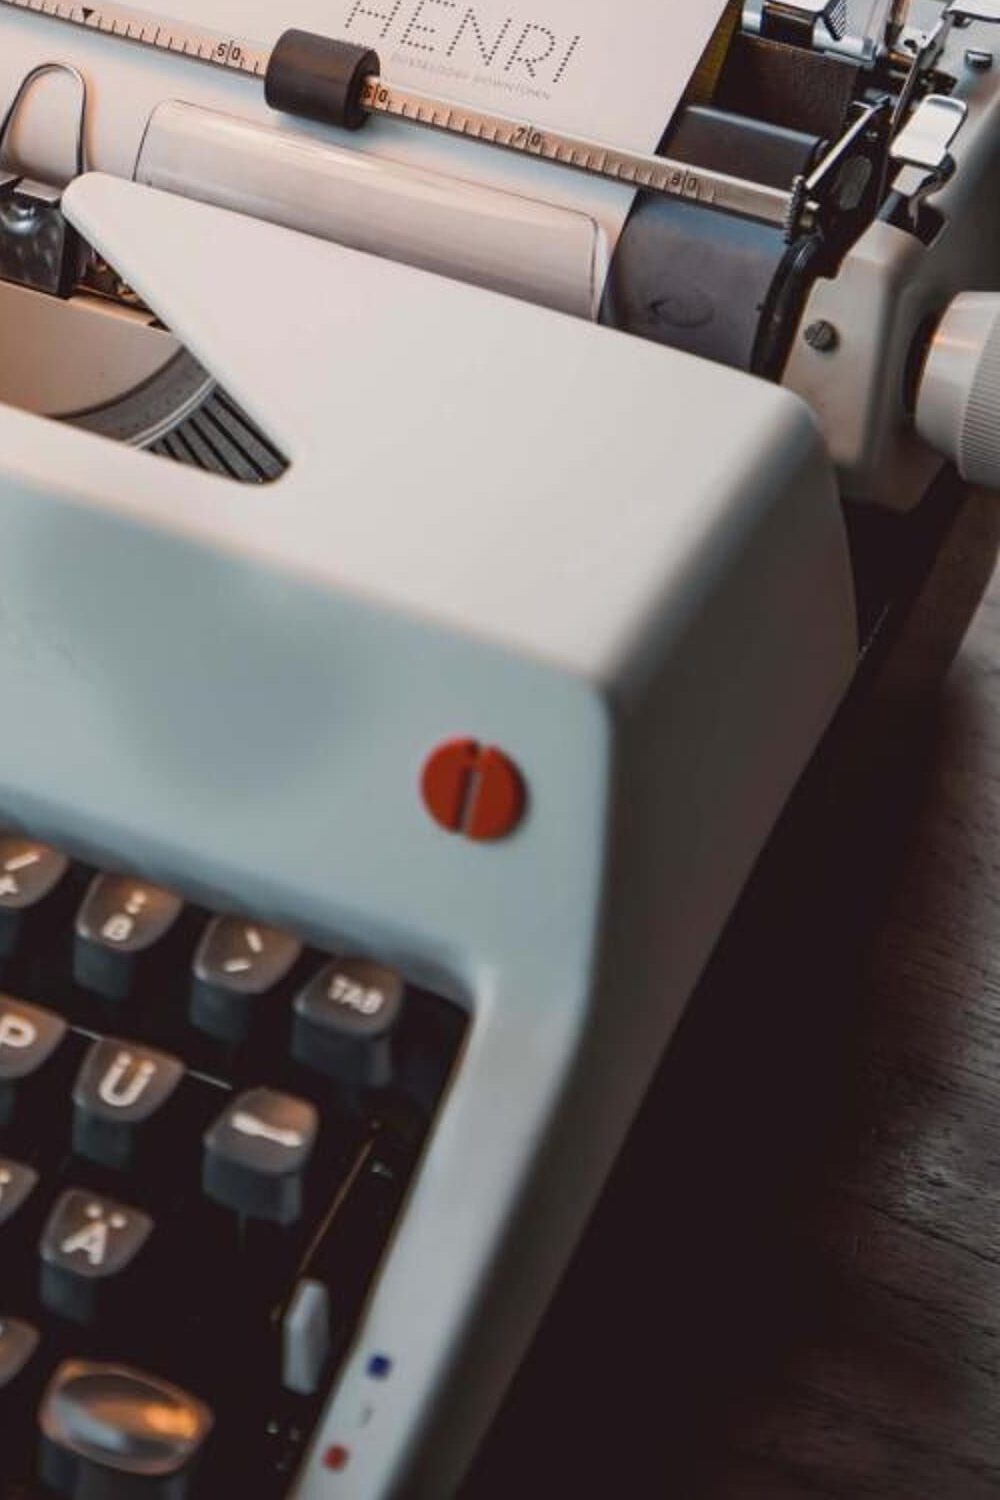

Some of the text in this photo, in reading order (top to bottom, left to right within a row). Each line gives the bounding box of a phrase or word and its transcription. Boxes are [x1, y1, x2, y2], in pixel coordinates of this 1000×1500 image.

[216, 42, 242, 62] 50
[514, 126, 542, 146] 70
[328, 973, 386, 1016] TAB
[99, 1054, 156, 1107] Ü
[61, 1204, 127, 1266] Ä
